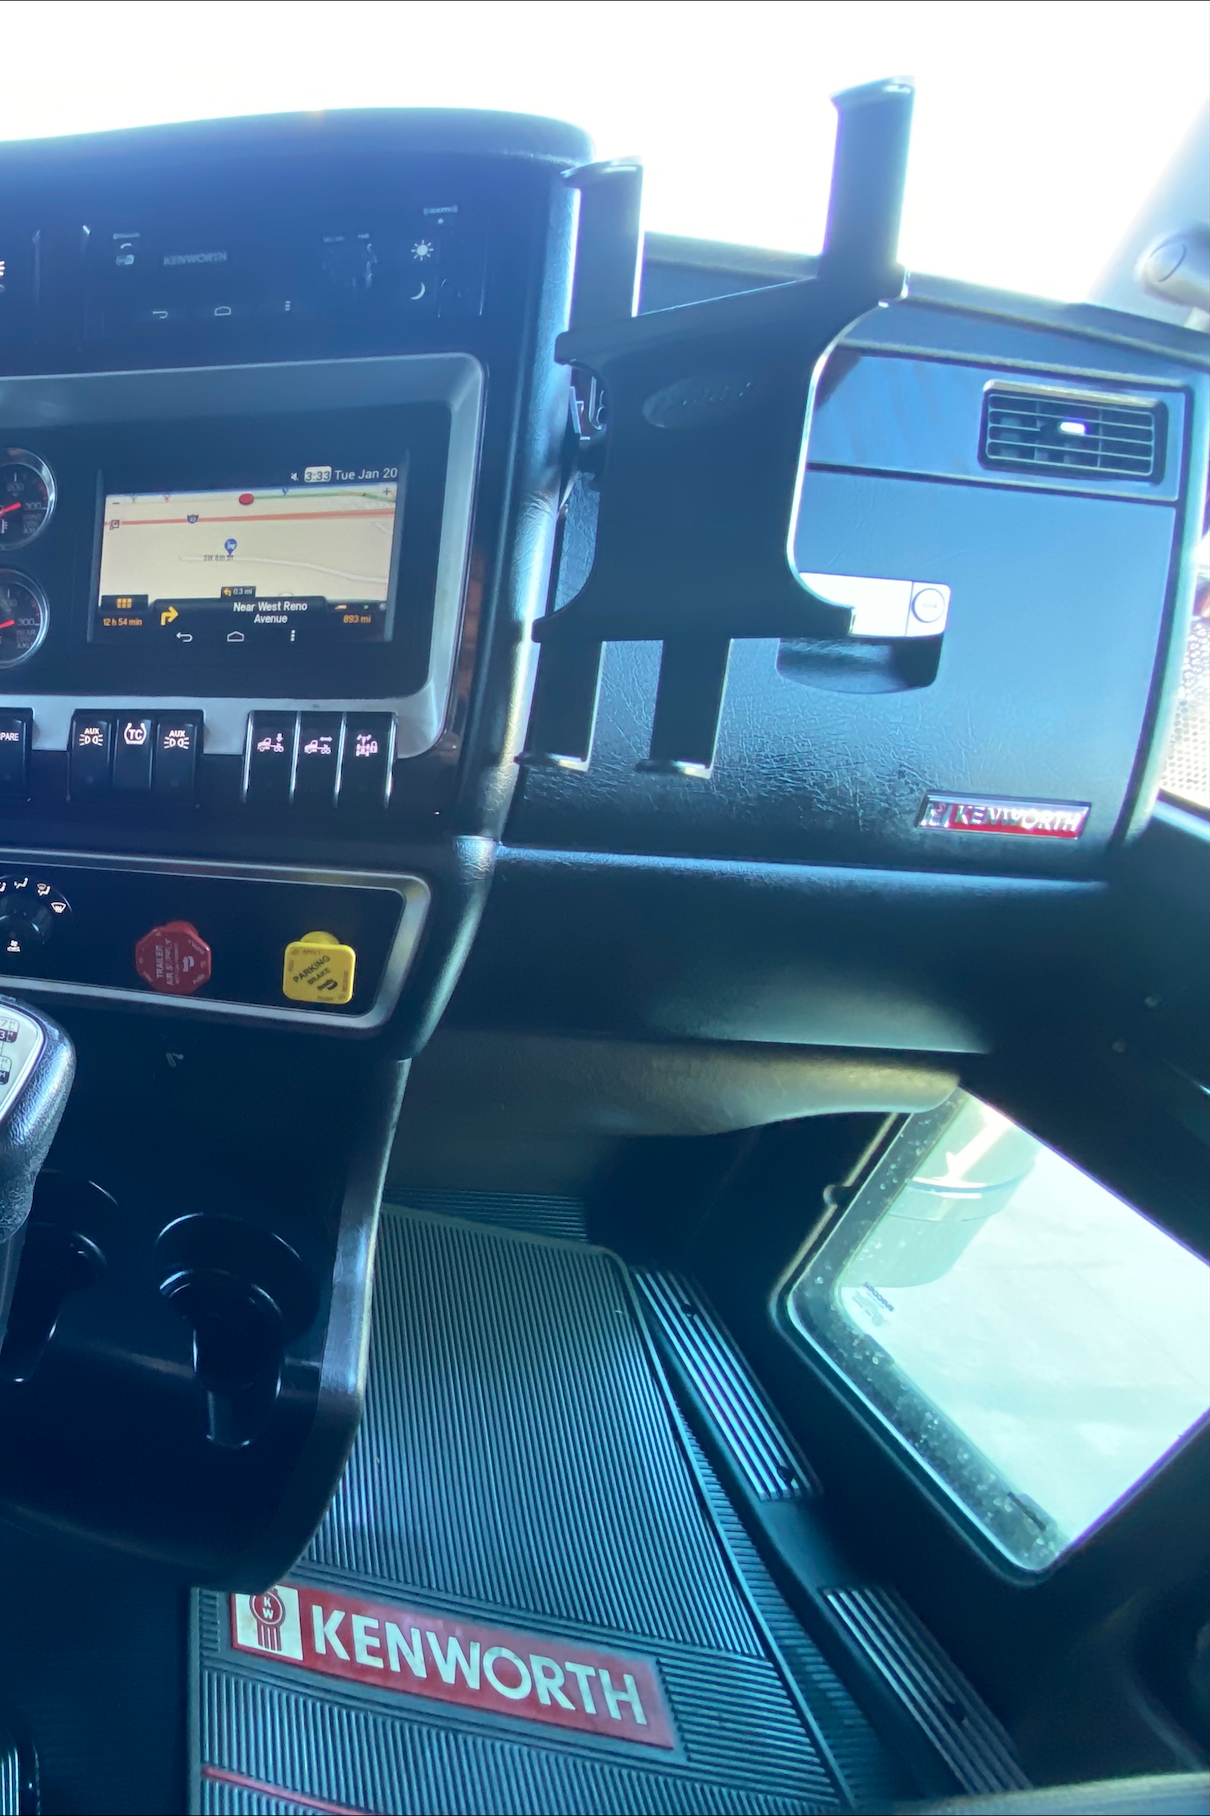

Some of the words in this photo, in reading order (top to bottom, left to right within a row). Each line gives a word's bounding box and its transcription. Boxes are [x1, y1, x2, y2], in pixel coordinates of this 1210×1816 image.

[164, 251, 227, 265] KENWORTH
[305, 471, 330, 481] 3:33
[335, 470, 355, 480] Tue
[358, 469, 379, 480] Jan
[383, 467, 398, 479] 20
[25, 502, 41, 510] 300
[233, 602, 255, 612] Near
[258, 602, 281, 611] West
[284, 602, 307, 611] Reno
[18, 618, 35, 626] 300
[103, 618, 110, 626] 12
[118, 618, 128, 626] 54
[129, 618, 142, 626] min
[254, 614, 288, 623] Avenue
[343, 615, 359, 623] 893
[361, 615, 371, 623] mi
[129, 729, 142, 739] TC
[955, 805, 1082, 831] KENWORTH
[293, 955, 331, 983] PARKING
[308, 968, 331, 985] BRAKE
[0, 1019, 8, 1027] 7
[262, 1607, 274, 1619] W
[313, 1604, 647, 1726] KENWORTH
